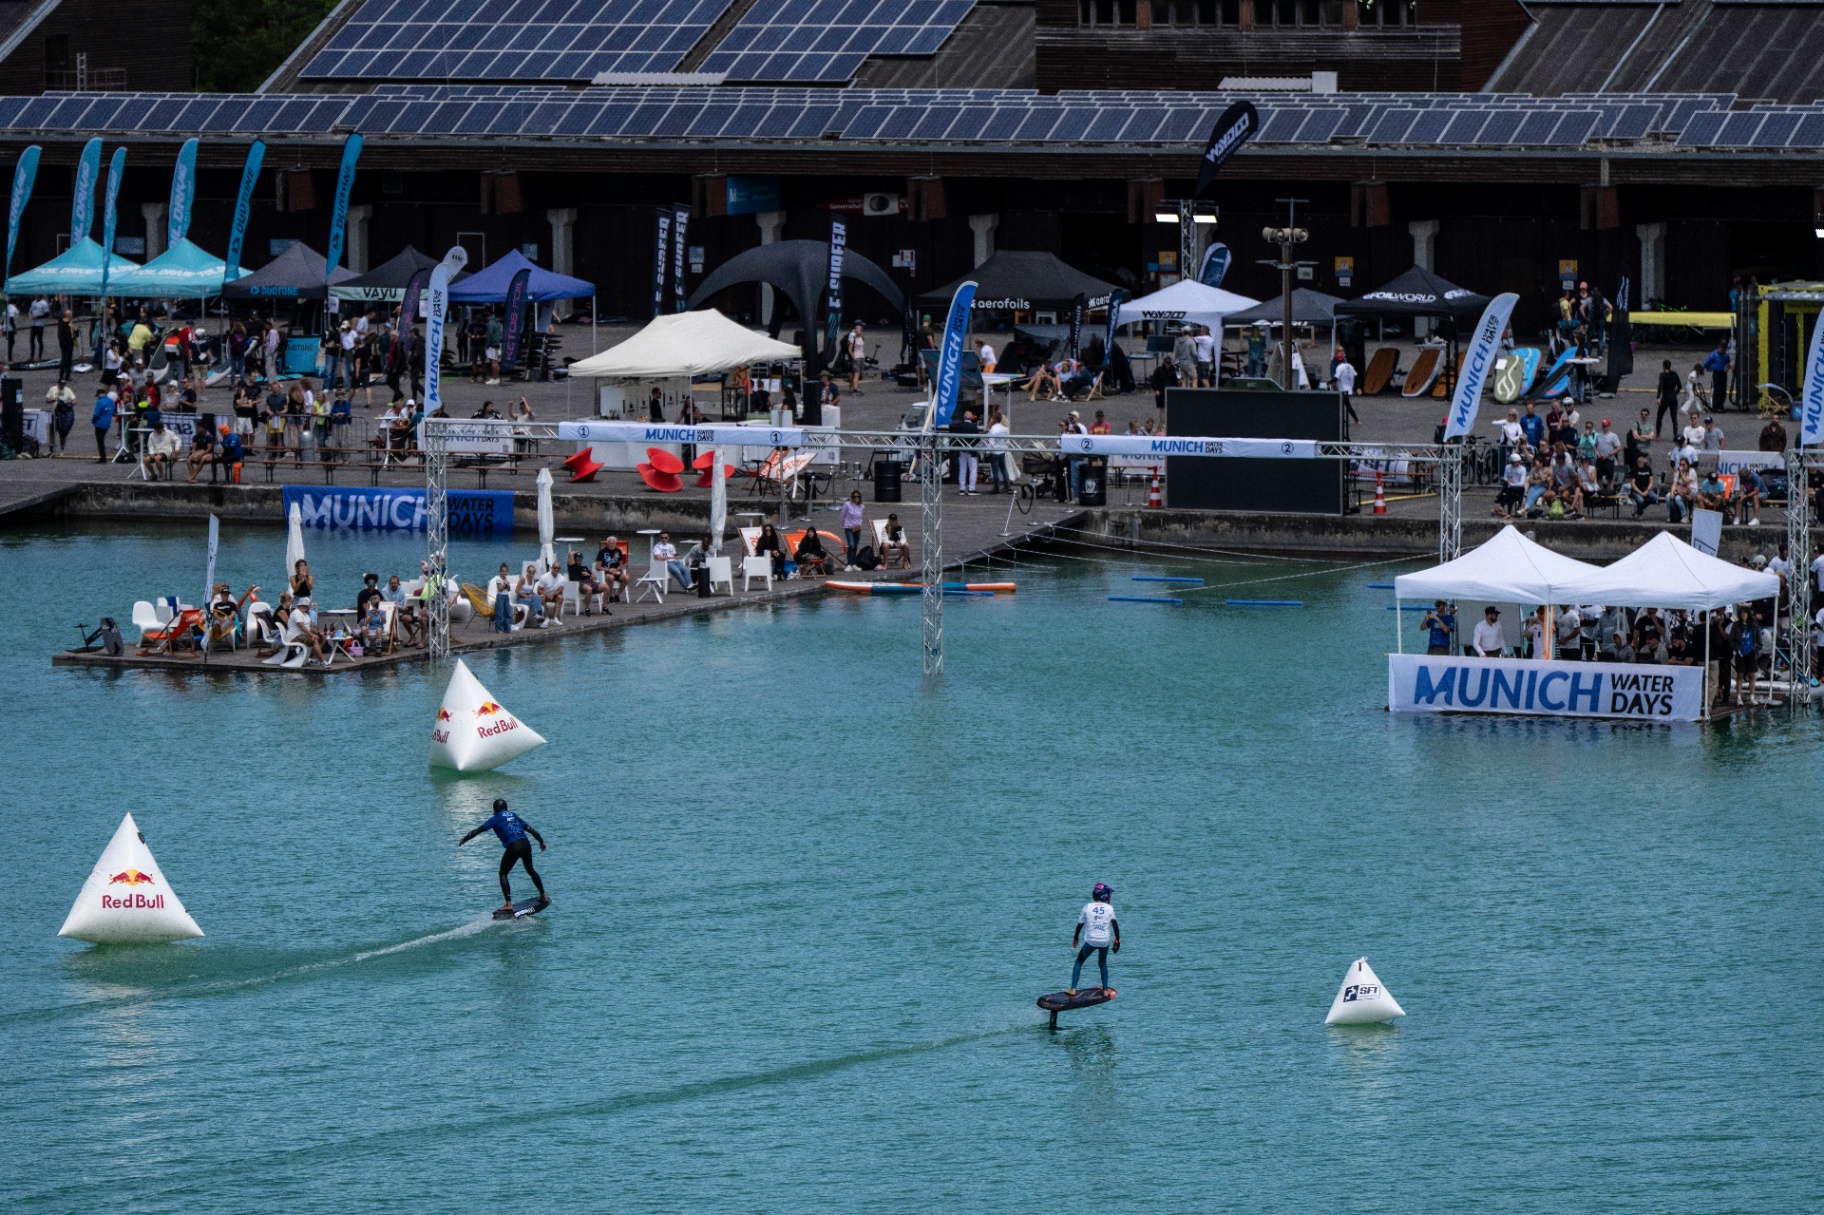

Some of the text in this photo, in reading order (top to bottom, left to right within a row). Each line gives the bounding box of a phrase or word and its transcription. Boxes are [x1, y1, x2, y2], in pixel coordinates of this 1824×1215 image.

[1206, 112, 1249, 162] WAYDOO
[235, 166, 255, 235] DUOTONE
[261, 286, 298, 296] DUOTONE
[977, 298, 1030, 309] aerofoils
[1141, 311, 1187, 319] WAYDOO
[1485, 318, 1499, 345] DAYS
[429, 319, 442, 403] MUNICH
[938, 331, 962, 417] MUNICH
[1456, 342, 1490, 428] MUNICH
[645, 429, 695, 442] MUNICH
[1151, 440, 1203, 453] MUNICH
[302, 493, 433, 528] MUNICH
[449, 498, 495, 512] WATER
[449, 511, 494, 530] DAYS
[1414, 665, 1603, 713] MUNICH
[1611, 673, 1674, 693] WATER
[1611, 692, 1673, 716] DAYS
[477, 717, 519, 739] Red Bull
[102, 893, 165, 909] Red Bull
[1092, 906, 1105, 915] 45
[1359, 986, 1379, 995] SFT
